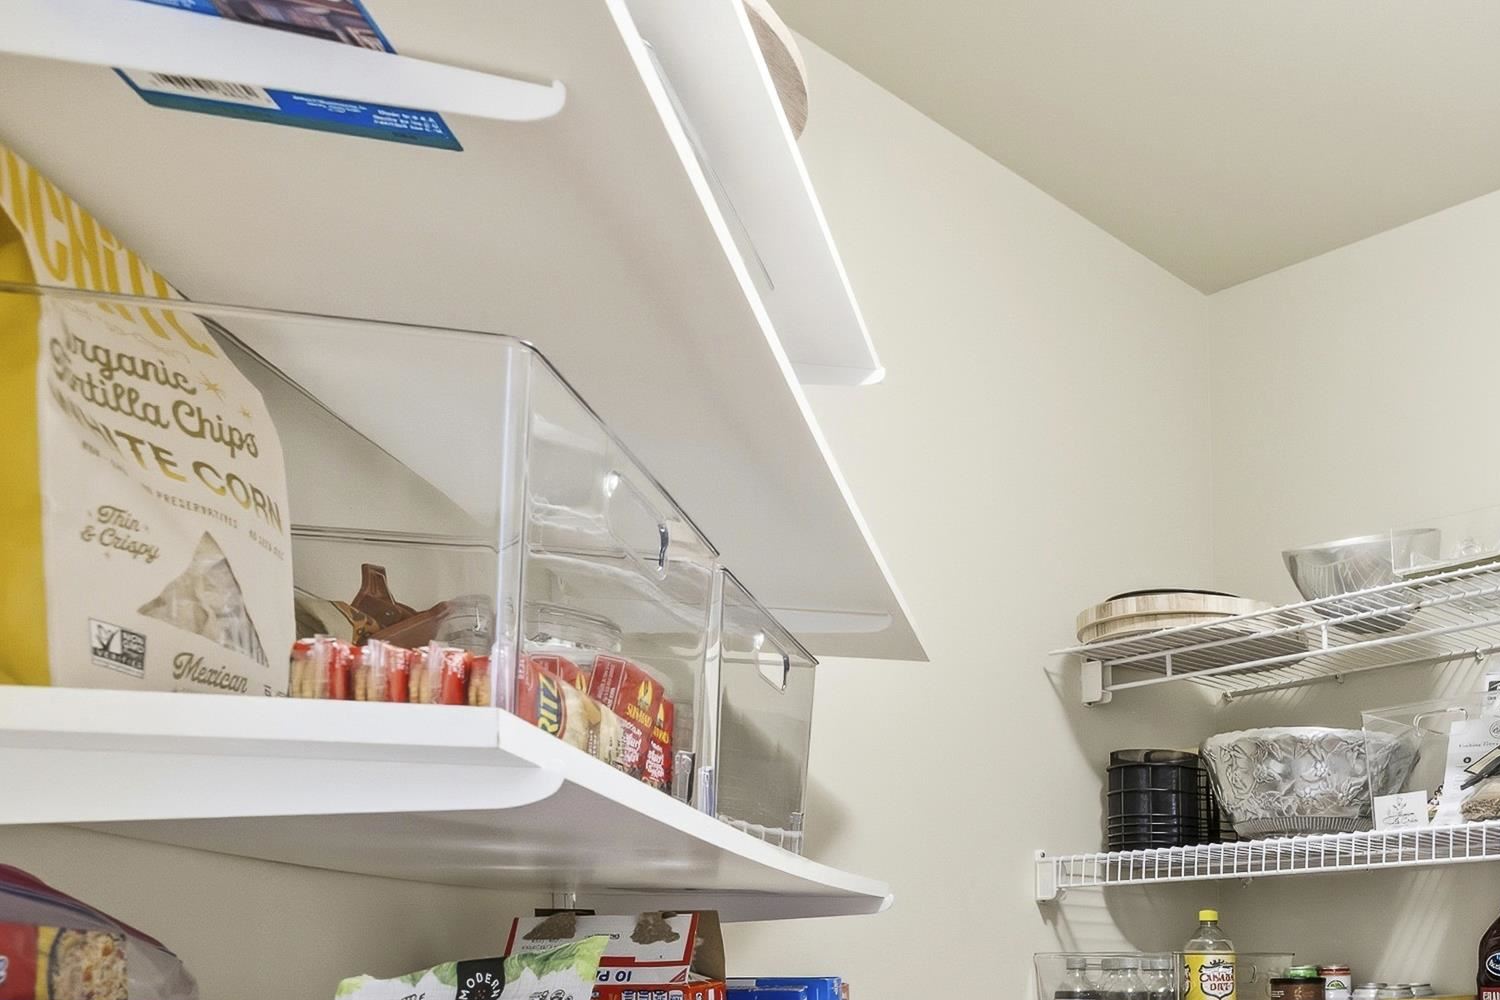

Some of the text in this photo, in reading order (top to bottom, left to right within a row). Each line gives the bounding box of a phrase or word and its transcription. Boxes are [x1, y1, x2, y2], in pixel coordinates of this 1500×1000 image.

[171, 399, 260, 459] Chips
[191, 460, 284, 535] CORN
[97, 504, 141, 533] Thin
[80, 525, 161, 564] & Crispy
[172, 651, 249, 695] Mexican
[458, 972, 501, 1000] MODERN
